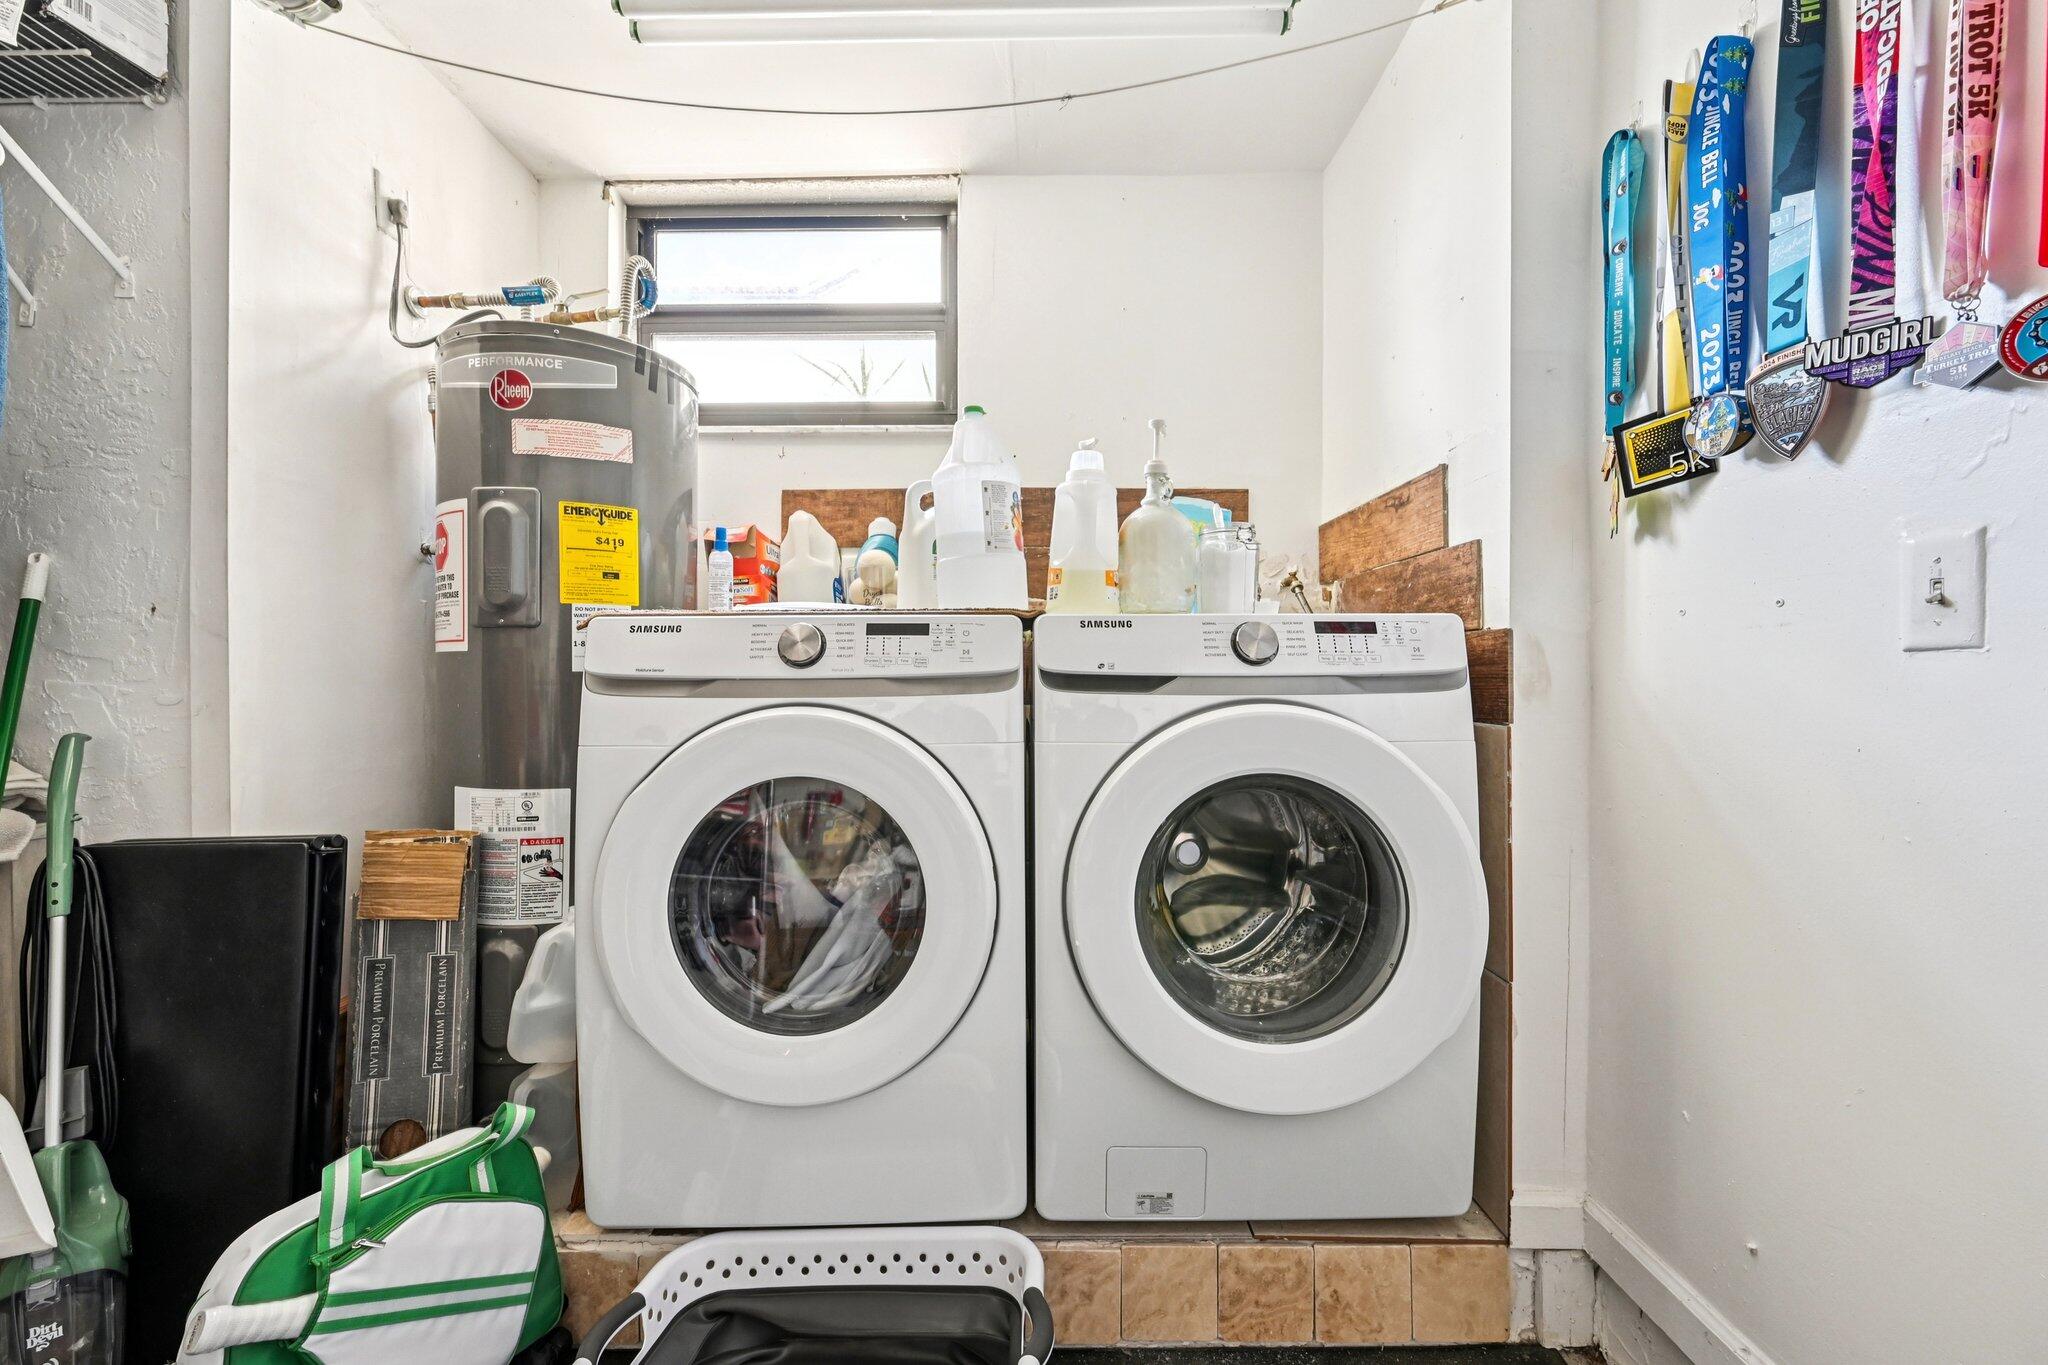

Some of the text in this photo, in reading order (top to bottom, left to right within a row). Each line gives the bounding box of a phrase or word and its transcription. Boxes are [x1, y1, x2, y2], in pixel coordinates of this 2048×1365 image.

[1968, 3, 1995, 118] TROT 5K
[1693, 106, 1721, 394] JINGLE BELL JOG 2023
[1614, 257, 1624, 298] CONSERVE
[1772, 272, 1804, 331] VR
[1613, 309, 1622, 346] EDUCATE
[1804, 317, 1940, 370] MUDGIRL
[468, 355, 563, 370] PERFORMANCE
[1612, 357, 1621, 388] INSPIRE
[1760, 359, 1776, 371] 2024
[1949, 363, 1968, 376] 5K
[494, 369, 530, 404] Rheem
[1764, 404, 1814, 432] GLACIER
[563, 504, 633, 522] ENERGYGUIDE
[595, 536, 625, 548] $419
[629, 624, 683, 634] SAMSUNG
[1079, 619, 1133, 629] SAMSUNG
[369, 962, 386, 1077] PREMIUM PORCELAIN
[433, 958, 447, 1070] PREMIUM PORCELAIN
[26, 1325, 64, 1351] Devil
[28, 1321, 58, 1338] Dirt
